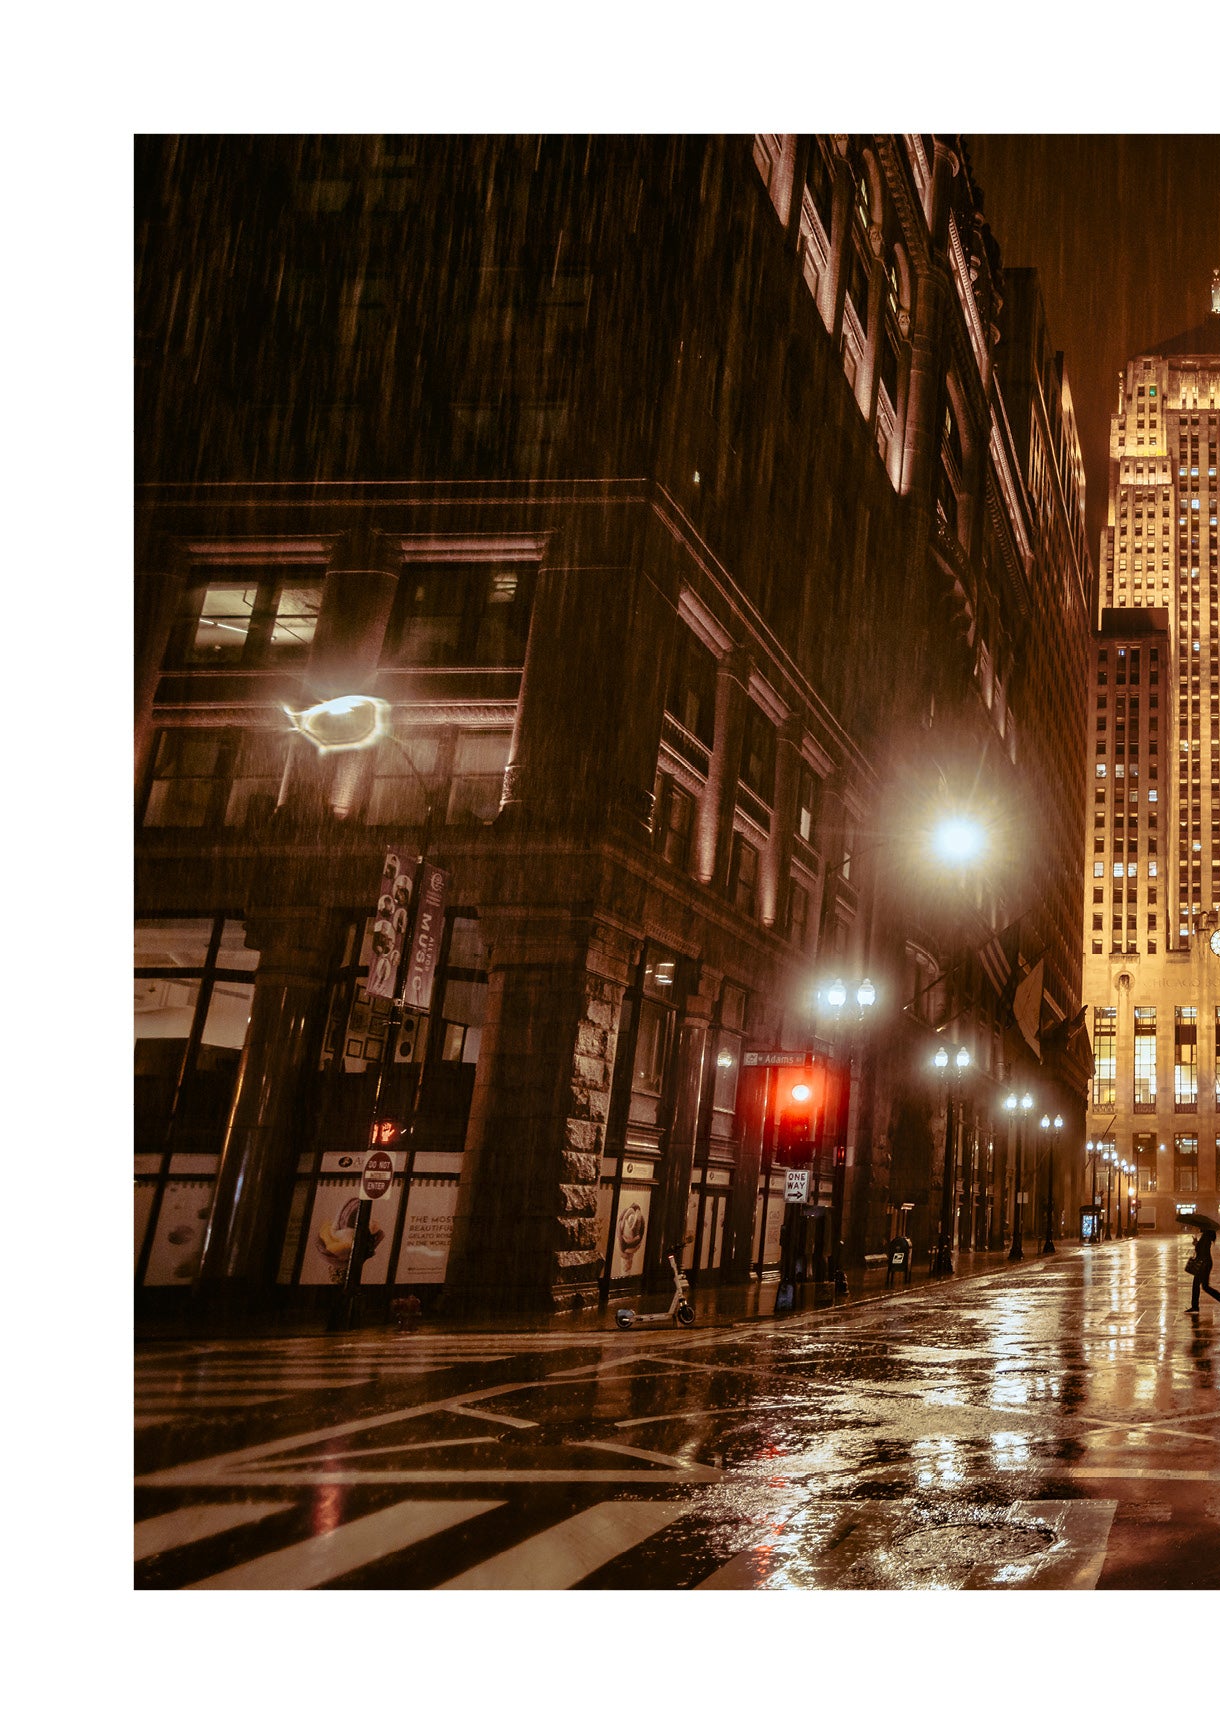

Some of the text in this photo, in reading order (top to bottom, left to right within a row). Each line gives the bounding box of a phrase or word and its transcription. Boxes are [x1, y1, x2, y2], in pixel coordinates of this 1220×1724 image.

[412, 912, 433, 991] MUSIC
[764, 1054, 794, 1065] Adams
[368, 1160, 377, 1169] DO
[378, 1161, 391, 1169] NOT
[788, 1172, 806, 1181] ONE
[367, 1182, 386, 1190] ENTER
[787, 1181, 806, 1190] WAY
[431, 1215, 455, 1223] MOST
